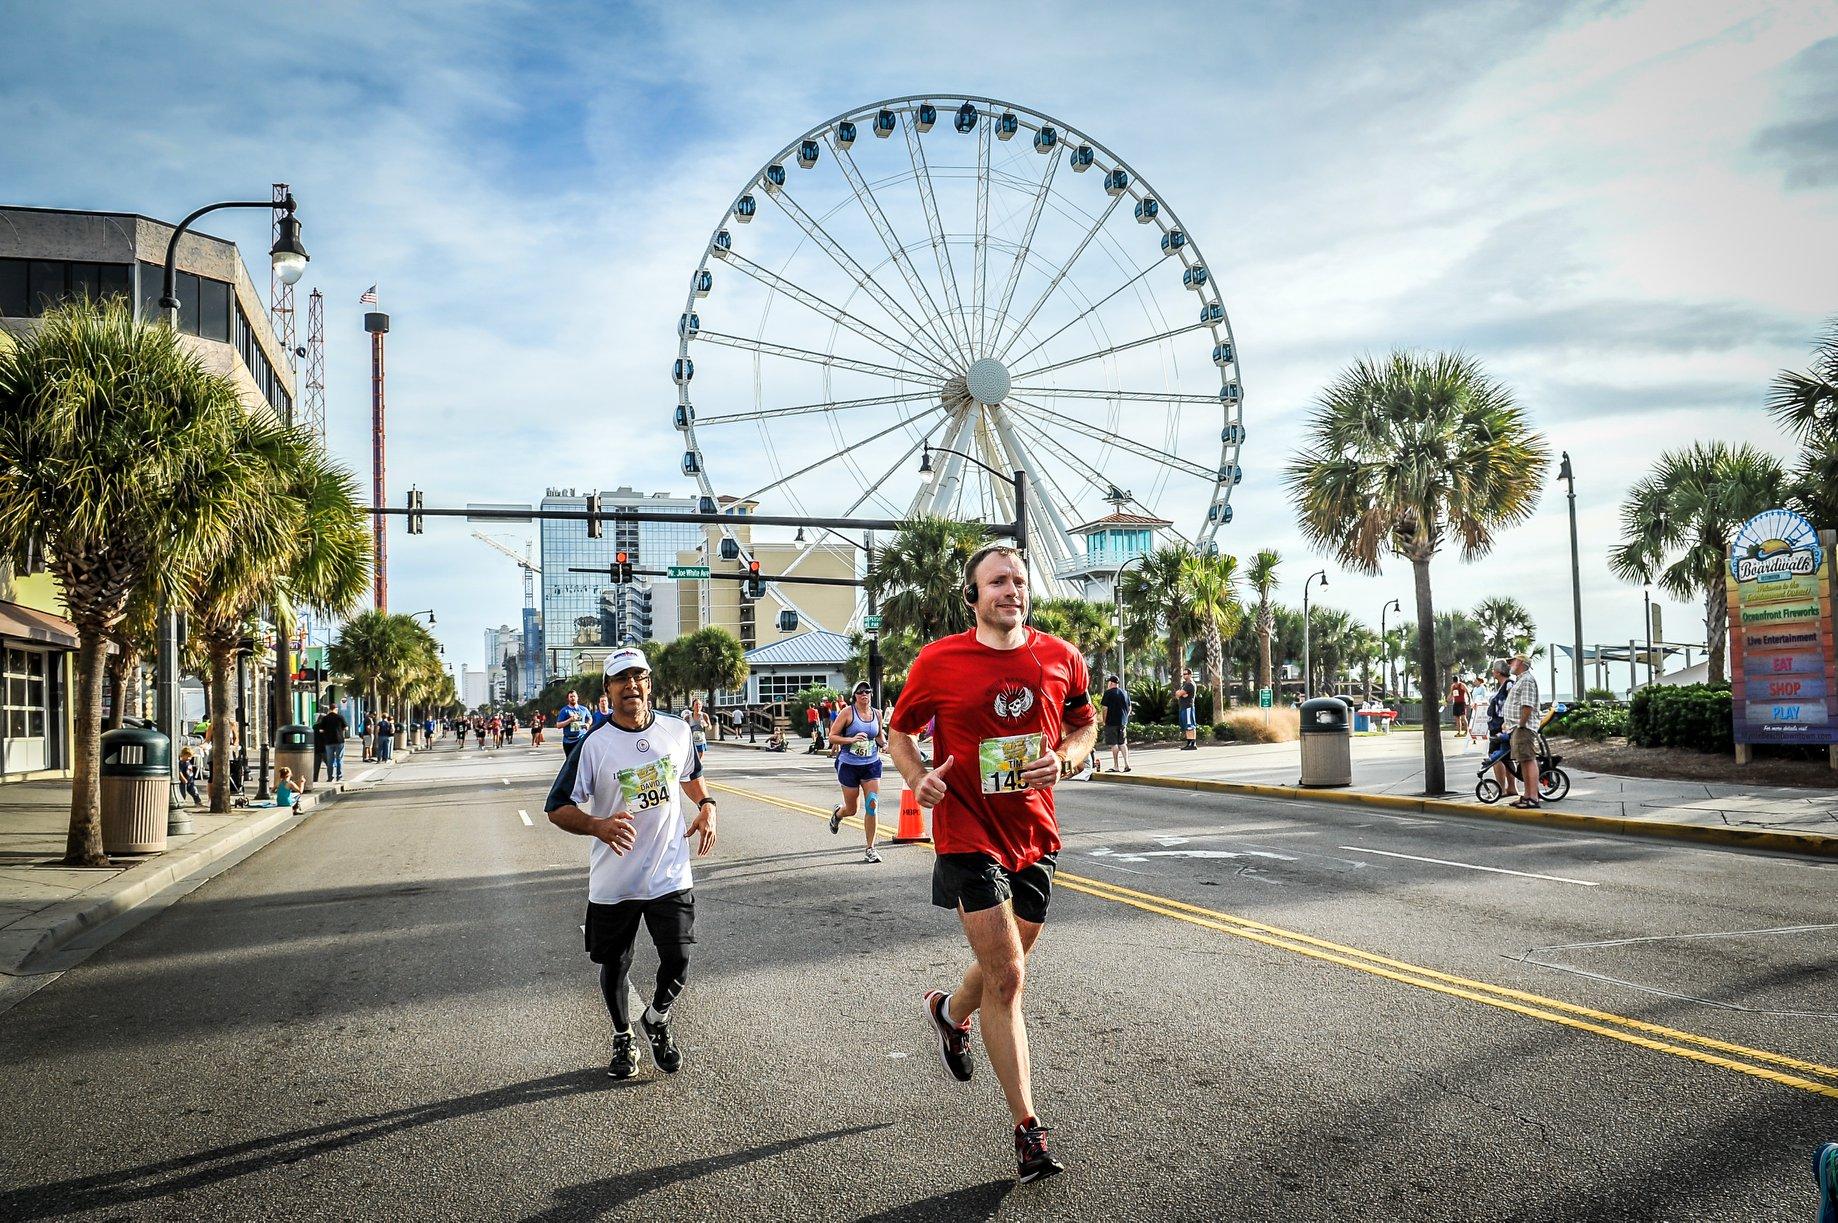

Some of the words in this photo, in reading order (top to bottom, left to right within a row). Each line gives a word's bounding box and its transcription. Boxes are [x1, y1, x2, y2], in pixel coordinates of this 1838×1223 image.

[677, 569, 685, 577] Joe
[686, 569, 700, 577] White
[1741, 556, 1809, 577] Boardwalk
[1743, 610, 1782, 621] Oceanfront
[1783, 606, 1819, 617] Fireworks
[1747, 636, 1761, 645] Live
[1763, 633, 1817, 643] Entertainment
[1773, 657, 1793, 670] EAT
[1770, 682, 1801, 695] SHOP
[1773, 706, 1800, 719] PLAY
[1009, 759, 1023, 768] TIM
[640, 779, 660, 791] DAVID
[637, 786, 669, 809] 394
